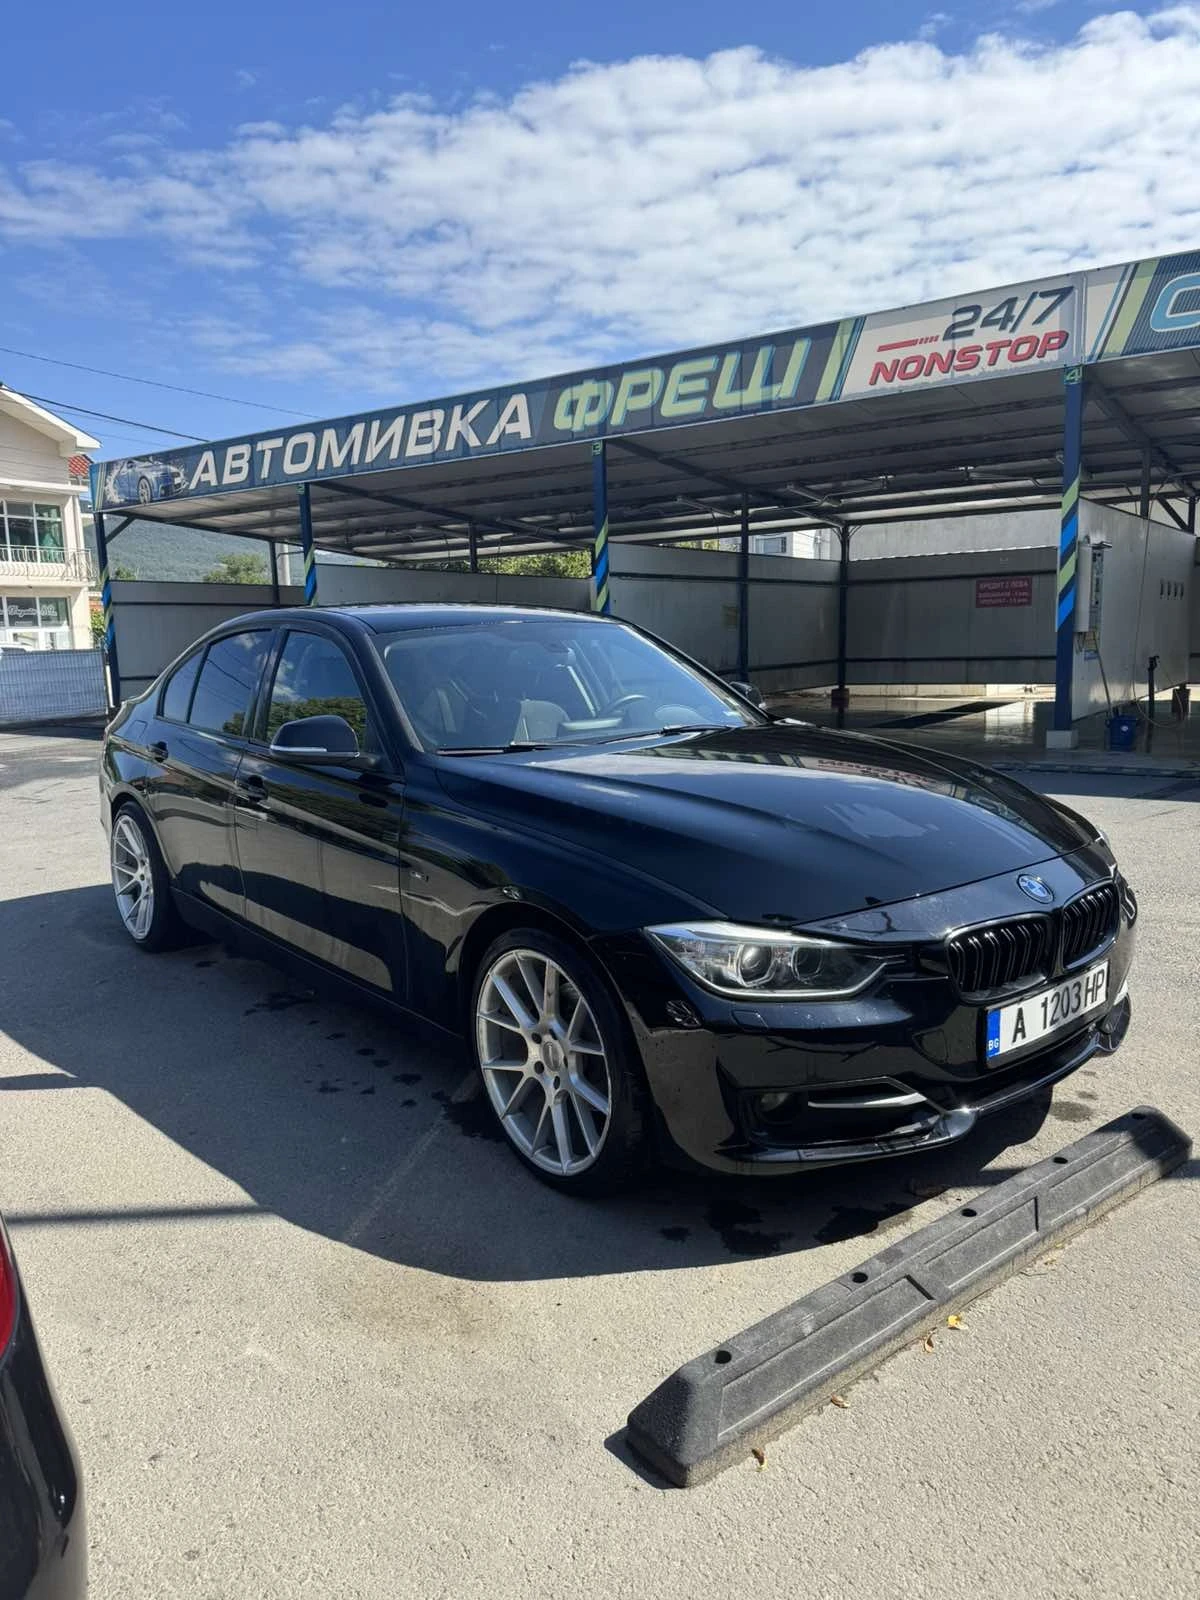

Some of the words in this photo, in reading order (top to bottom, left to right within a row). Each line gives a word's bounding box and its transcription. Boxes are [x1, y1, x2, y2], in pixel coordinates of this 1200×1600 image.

[942, 285, 1075, 342] 24/7
[868, 329, 1070, 386] NONSTOP
[1065, 367, 1081, 382] 4
[189, 392, 533, 490] АВТОМИВКА
[553, 336, 812, 433] ФРЕШ
[1012, 1007, 1026, 1043] A
[1041, 981, 1082, 1030] 1203
[1083, 969, 1105, 1007] HP
[988, 1038, 999, 1051] BG
